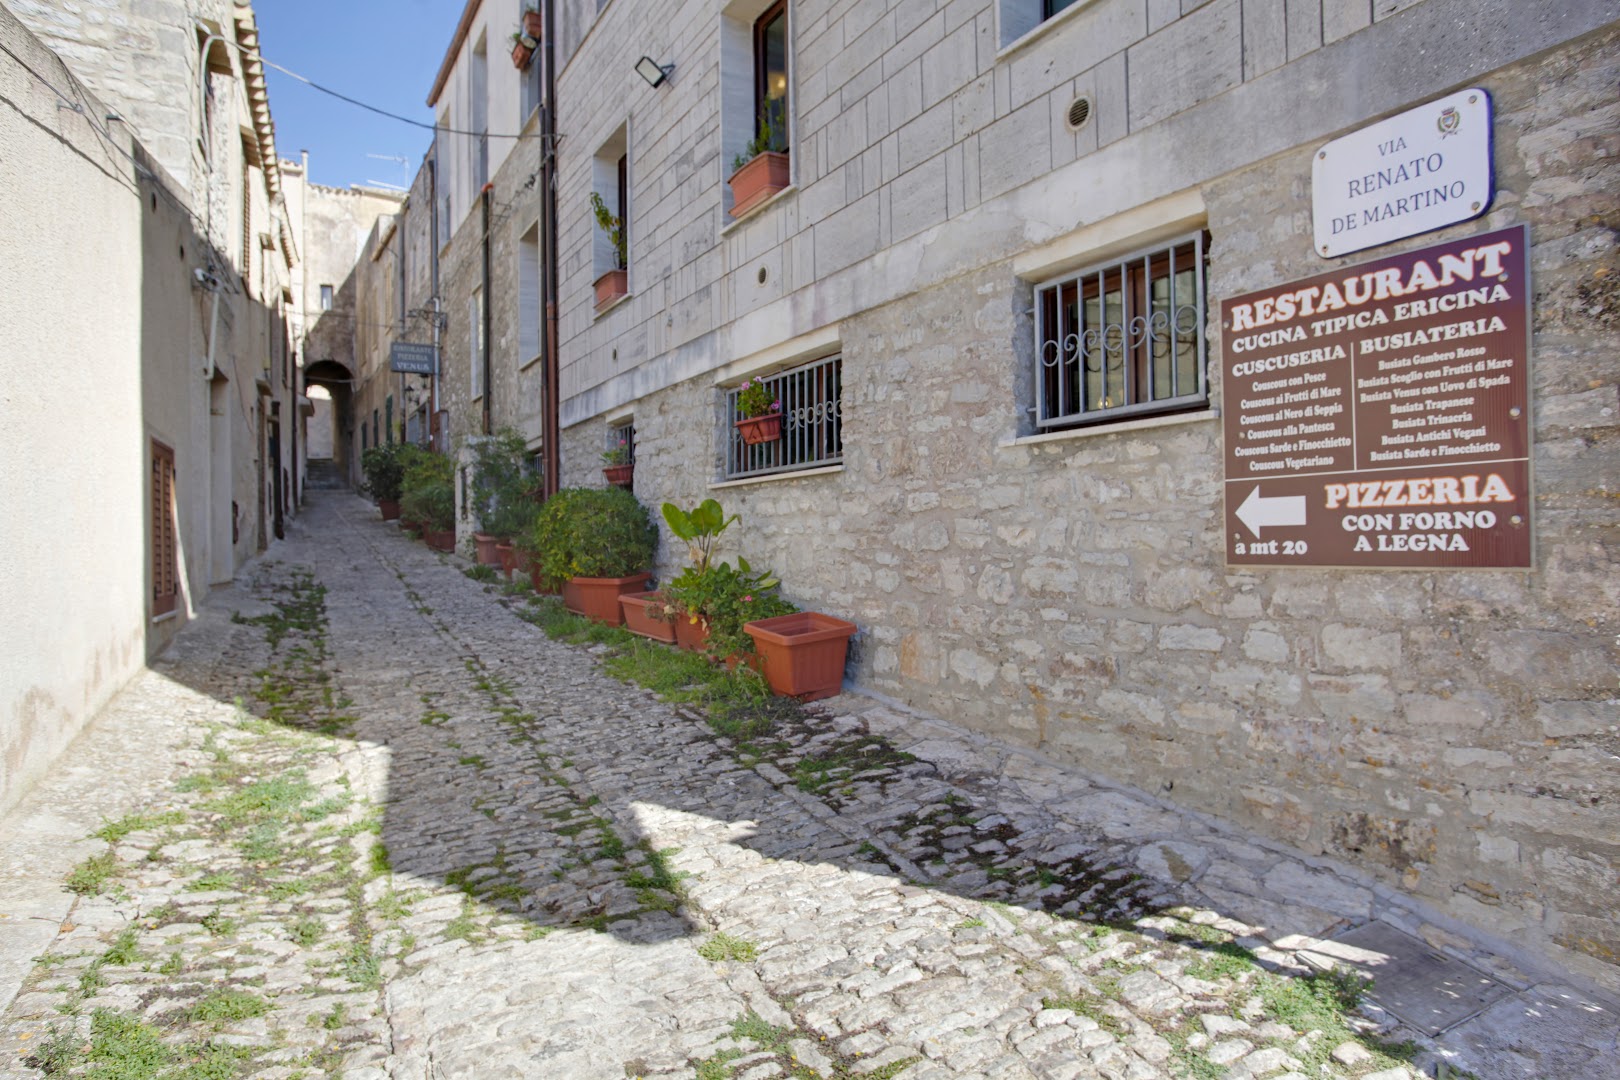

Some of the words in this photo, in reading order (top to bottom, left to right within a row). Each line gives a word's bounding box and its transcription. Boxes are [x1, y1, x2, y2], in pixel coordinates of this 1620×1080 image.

[1378, 137, 1407, 156] VIA
[1348, 153, 1443, 199] RENATO
[1332, 214, 1357, 234] DE
[1363, 181, 1465, 226] MARTINO
[1231, 241, 1512, 332] RESTAURANT
[1232, 326, 1308, 352] CUCINA
[1311, 308, 1388, 337] TIPICA
[1394, 284, 1511, 321] ERICINA
[1360, 316, 1507, 354] BUSIATERIA
[1232, 345, 1346, 377] CUSCUSERIA
[1378, 357, 1411, 370] Busiata
[1413, 350, 1455, 365] Gambero
[1456, 346, 1486, 359] Rosso
[1253, 379, 1287, 392] Couscous
[1289, 377, 1303, 385] con
[1304, 372, 1326, 383] Pesce
[1358, 375, 1389, 388] Busiata
[1390, 370, 1423, 384] Scoglio
[1424, 368, 1441, 378] con
[1442, 362, 1473, 377] Frutti
[1474, 361, 1485, 371] di
[1487, 358, 1513, 370] Mare
[1241, 397, 1275, 409] Couscous
[1276, 394, 1283, 404] ai
[1284, 391, 1309, 403] Frutti
[1310, 389, 1318, 399] di
[1320, 387, 1341, 398] Mare
[1360, 389, 1392, 403] Busiata
[1393, 386, 1420, 397] Venus
[1421, 384, 1438, 394] con
[1440, 381, 1465, 393] Uovo
[1466, 378, 1477, 389] di
[1478, 375, 1510, 388] Spada
[1240, 413, 1274, 425] Couscous
[1275, 410, 1283, 420] al
[1284, 409, 1303, 419] Nero
[1304, 406, 1313, 416] di
[1314, 402, 1343, 416] Seppia
[1390, 401, 1424, 414] Busiata
[1425, 396, 1474, 410] Trapanese
[1247, 428, 1282, 439] Couscous
[1283, 425, 1297, 436] alla
[1299, 422, 1335, 434] Pantesca
[1392, 416, 1426, 429] Busiata
[1427, 412, 1472, 425] Trinacria
[1381, 432, 1414, 445] Busiata
[1416, 430, 1451, 442] Antichi
[1453, 426, 1486, 440] Vegani
[1235, 445, 1268, 456] Couscous
[1269, 442, 1291, 453] Sarde
[1299, 437, 1351, 450] Finocchietto
[1370, 449, 1403, 461] Busiata
[1404, 446, 1430, 458] Sarde
[1432, 447, 1437, 456] e
[1438, 442, 1500, 456] Finocchietto
[1250, 459, 1284, 471] Couscous
[1285, 455, 1334, 470] Vegetariano
[1324, 474, 1514, 509] PIZZERIA
[1342, 513, 1394, 531] CON
[1399, 510, 1496, 530] FORNO
[1235, 542, 1246, 554] a
[1250, 540, 1278, 554] mt
[1282, 540, 1308, 555] 20
[1354, 534, 1372, 552] A
[1377, 533, 1470, 552] LEGNA
